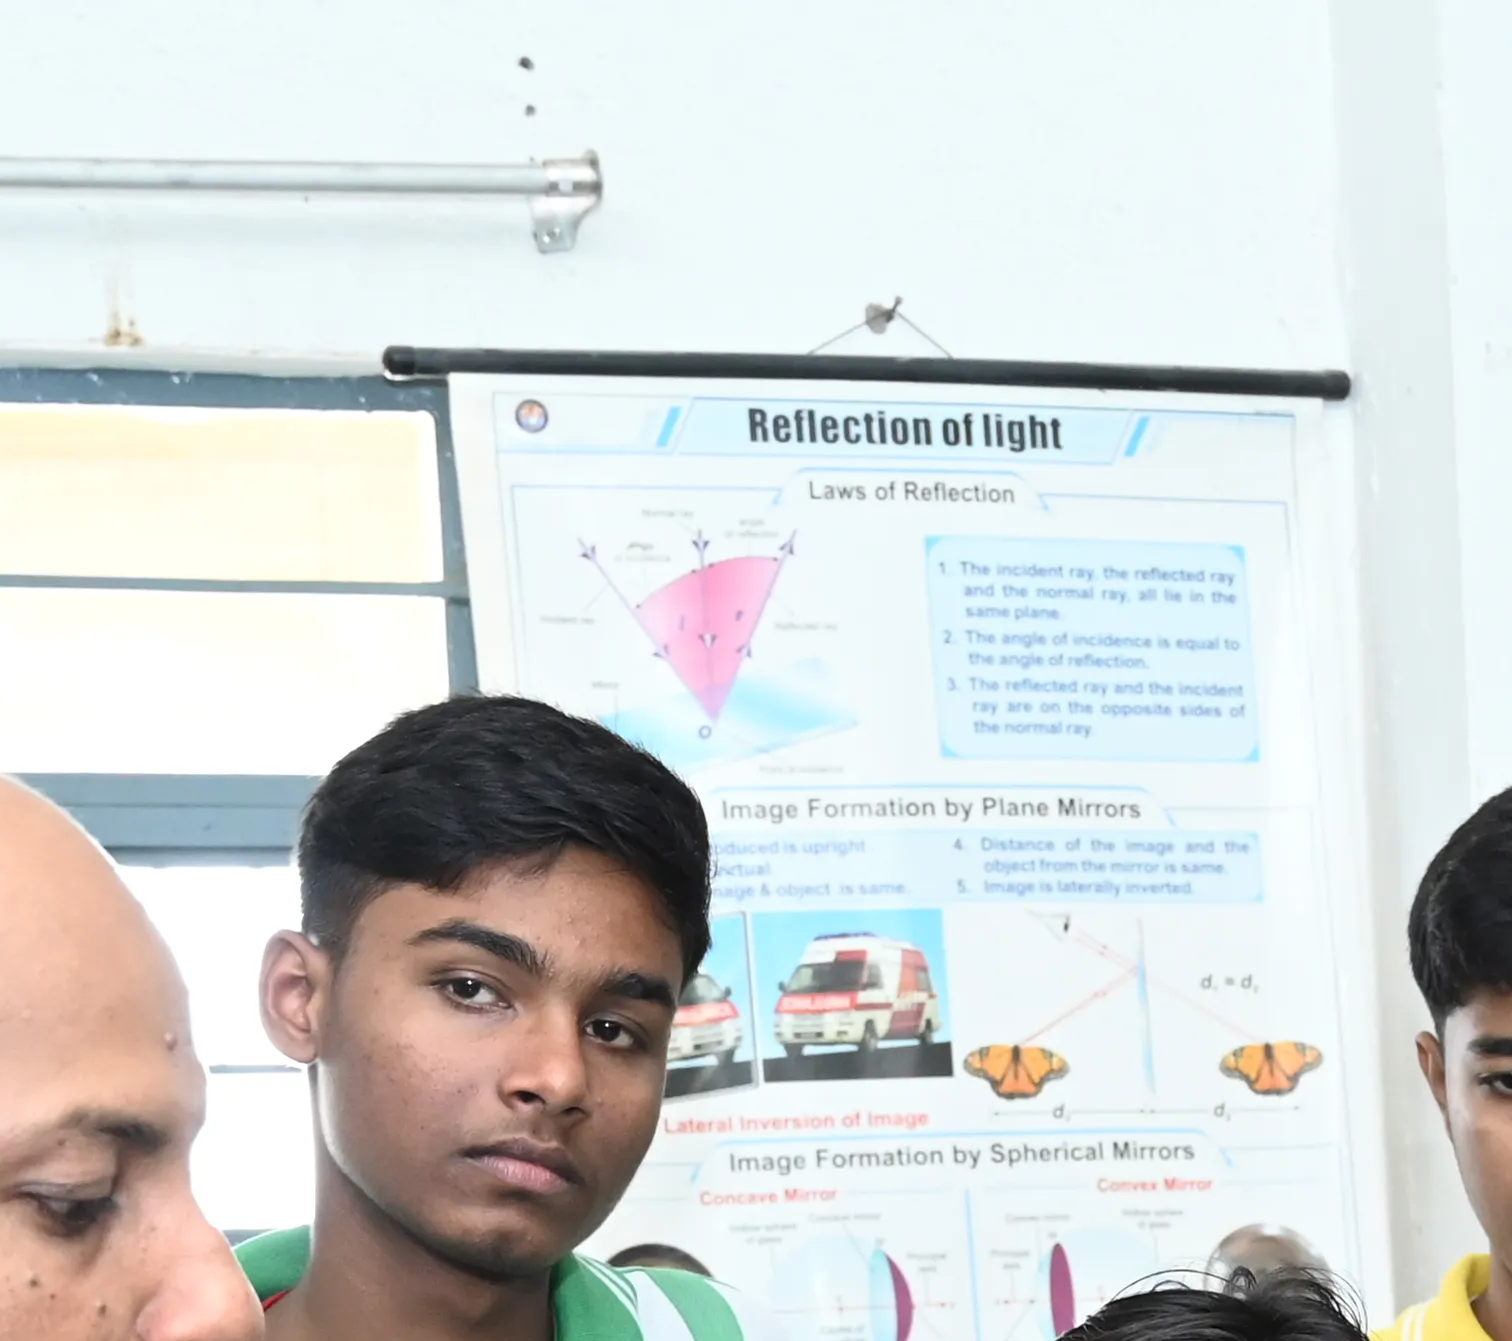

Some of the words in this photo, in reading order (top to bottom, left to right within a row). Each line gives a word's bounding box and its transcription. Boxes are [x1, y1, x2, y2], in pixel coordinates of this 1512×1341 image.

[747, 407, 932, 447] Reflection
[942, 413, 974, 447] of
[982, 414, 1063, 452] light
[808, 480, 867, 501] Laws
[875, 481, 895, 501] of
[904, 481, 1015, 504] Reflection
[959, 560, 990, 576] The
[996, 562, 1063, 578] incident
[1103, 565, 1128, 581] the
[1134, 566, 1205, 583] reflected
[1210, 570, 1236, 586] ray
[963, 583, 994, 598] and
[1002, 584, 1028, 599] the
[1036, 585, 1094, 600] normal
[1138, 588, 1157, 604] all
[1164, 588, 1183, 604] lie
[1189, 589, 1205, 604] in
[1211, 589, 1237, 605] the
[964, 606, 1010, 620] same
[965, 629, 996, 645] The
[1001, 630, 1047, 649] angle
[1052, 631, 1068, 646] of
[1071, 632, 1152, 649] incidence
[1157, 634, 1170, 649] is
[1175, 636, 1220, 652] equal
[1224, 638, 1240, 652] to
[968, 651, 994, 666] the
[999, 653, 1044, 670] angle
[1048, 653, 1064, 667] of
[969, 677, 1000, 693] The
[1005, 678, 1078, 694] reflected
[1083, 681, 1108, 697] ray
[1114, 680, 1144, 696] and
[1148, 681, 1174, 696] the
[1178, 682, 1244, 698] incident
[972, 701, 998, 716] ray
[1007, 700, 1033, 714] are
[1039, 701, 1061, 715] on
[1068, 700, 1093, 715] the
[1100, 703, 1173, 719] opposite
[1179, 703, 1222, 718] sides
[1229, 703, 1246, 718] of
[973, 720, 1000, 735] the
[1004, 720, 1062, 736] normal
[721, 798, 799, 825] Image
[808, 797, 936, 819] Formation
[944, 797, 973, 824] by
[982, 796, 1051, 818] Plane
[1058, 797, 1141, 819] Mirrors
[785, 841, 797, 855] is
[981, 837, 1056, 853] Distance
[1065, 838, 1082, 853] of
[1091, 839, 1117, 854] the
[1125, 839, 1174, 857] image
[1185, 840, 1215, 855] and
[1224, 840, 1250, 855] the
[983, 858, 1038, 876] object
[1040, 858, 1079, 874] from
[1081, 859, 1106, 874] the
[1109, 859, 1160, 874] mirror
[1164, 861, 1178, 875] is
[776, 882, 831, 899] object
[840, 883, 853, 896] is
[984, 879, 1036, 898] Image
[1039, 880, 1053, 895] is
[1057, 880, 1120, 899] laterally
[663, 1116, 733, 1135] Lateral
[739, 1113, 836, 1133] Inversion
[841, 1111, 862, 1129] of
[868, 1111, 930, 1133] Image
[728, 1150, 807, 1176] Image
[815, 1146, 945, 1170] Formation
[952, 1144, 982, 1170] by
[990, 1141, 1105, 1169] Spherical
[1112, 1138, 1196, 1161] Mirrors
[1096, 1177, 1158, 1193] Convex
[1163, 1174, 1214, 1192] Mirror
[699, 1189, 778, 1206] Concave
[784, 1187, 838, 1203] Mirror
